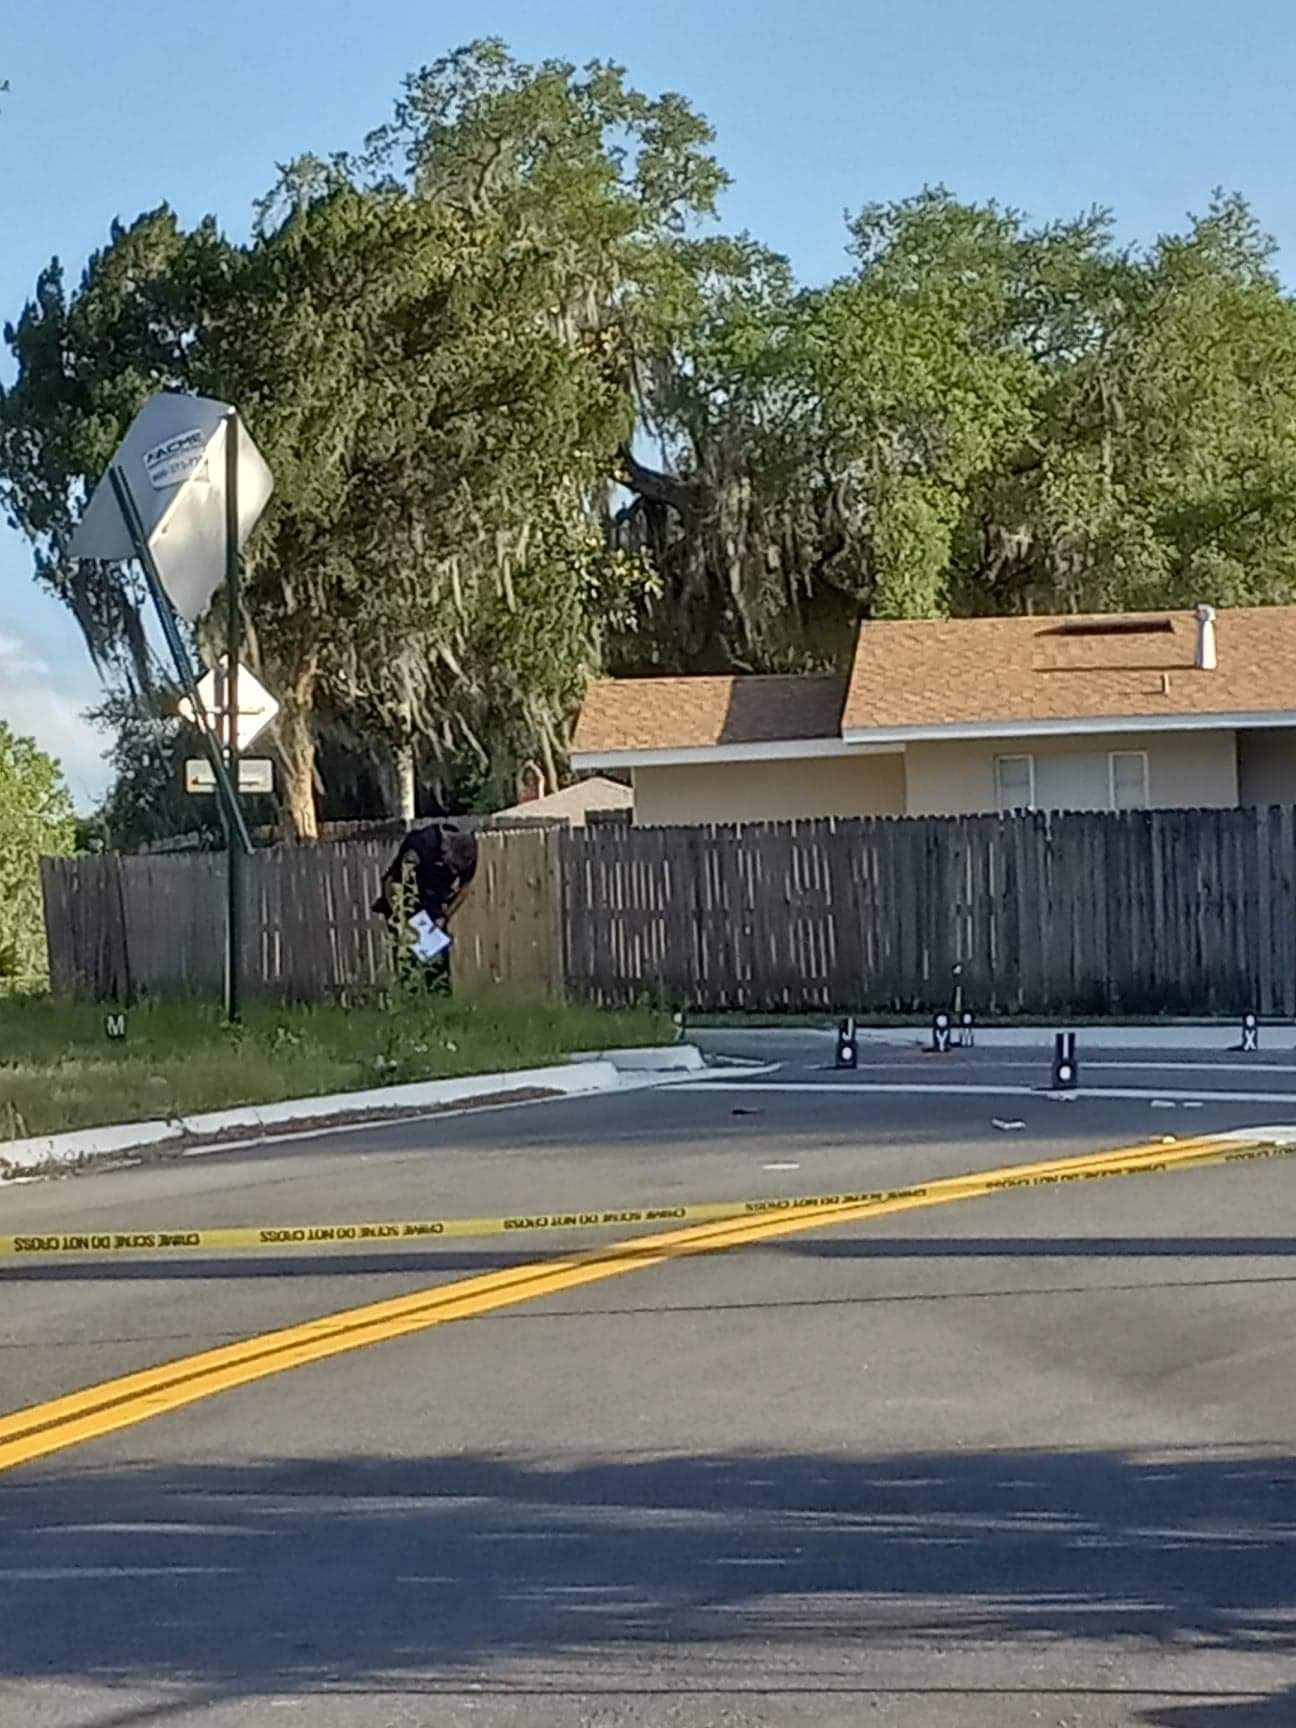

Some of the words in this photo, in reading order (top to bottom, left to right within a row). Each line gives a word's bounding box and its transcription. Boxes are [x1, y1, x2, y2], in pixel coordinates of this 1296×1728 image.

[107, 1014, 125, 1036] M
[841, 1017, 854, 1041] J
[935, 1029, 950, 1051] Y
[1244, 1029, 1257, 1051] X
[579, 1214, 599, 1225] DO
[260, 1230, 305, 1243] CROSS
[306, 1228, 335, 1241] NOT
[336, 1227, 356, 1240] DO
[14, 1236, 60, 1252] CROSS
[62, 1236, 89, 1251] NOT
[91, 1235, 110, 1250] DO
